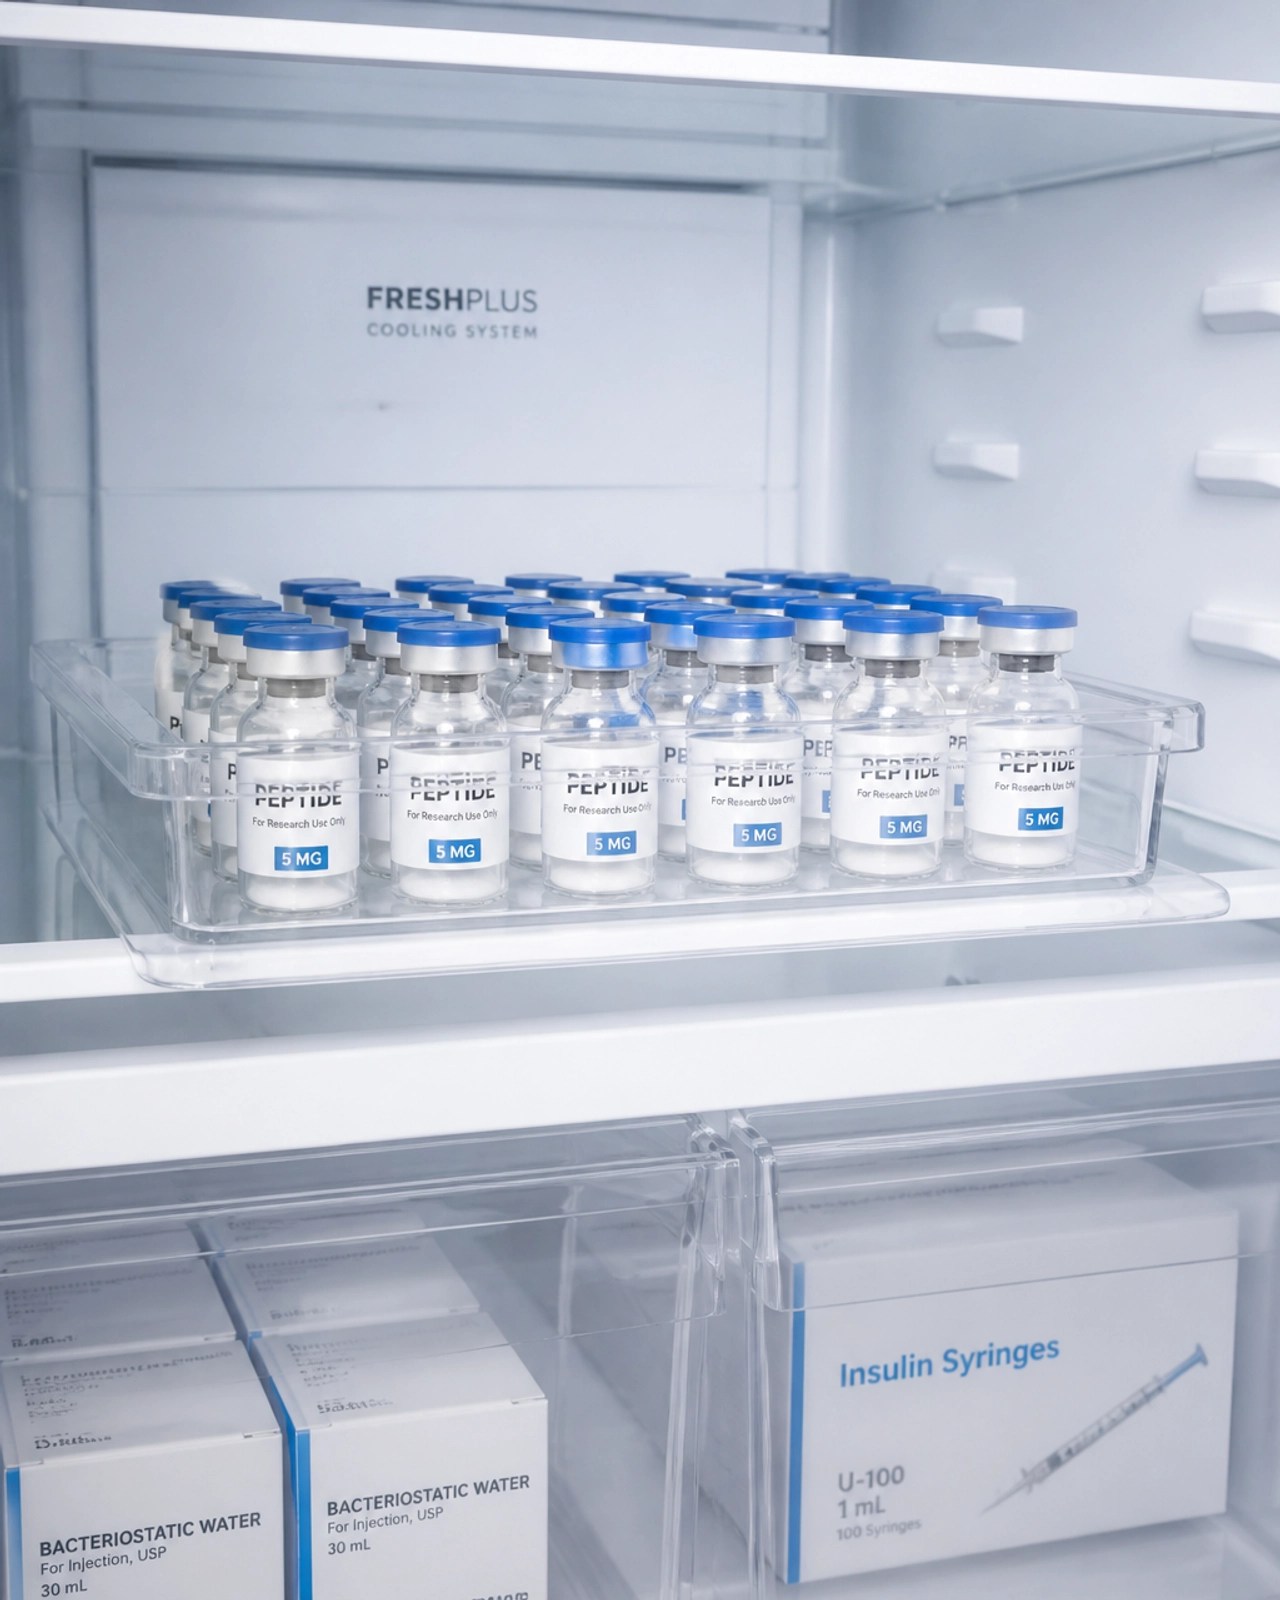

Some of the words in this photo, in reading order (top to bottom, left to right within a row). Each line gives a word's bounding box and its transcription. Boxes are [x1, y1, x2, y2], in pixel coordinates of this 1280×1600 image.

[366, 285, 539, 313] FRESHPLUS
[367, 322, 457, 338] COOLING
[465, 324, 539, 339] SYSTEM
[861, 756, 940, 780] PEPTIDE
[999, 748, 1075, 773] PEPTIDE
[567, 767, 650, 795] PEPTIDE
[714, 760, 795, 788] PEPTIDE
[255, 780, 342, 808] PEPTIDE
[410, 772, 496, 801] PEPTIDE
[857, 788, 871, 798] For
[873, 789, 913, 799] Research
[994, 781, 1009, 791] For
[563, 803, 577, 814] For
[579, 805, 621, 815] Research
[711, 796, 725, 806] For
[253, 816, 266, 827] For
[267, 818, 310, 829] Research
[407, 809, 420, 820] For
[422, 811, 464, 822] Research
[465, 811, 481, 821] Use
[1025, 813, 1034, 826] 5
[1038, 812, 1059, 825] MG
[741, 828, 750, 842] 5
[754, 827, 777, 842] MG
[887, 821, 896, 834] 5
[900, 820, 922, 834] MG
[436, 844, 446, 859] 5
[450, 843, 475, 859] MG
[594, 837, 604, 851] 5
[608, 836, 631, 850] MG
[282, 852, 292, 866] 5
[296, 850, 322, 866] MG
[841, 1353, 933, 1387] Insulin
[942, 1339, 1060, 1377] Syringes
[838, 1465, 905, 1492] U-100
[326, 1483, 469, 1516] BACTERIOSTATIC
[473, 1475, 530, 1496] WATER
[838, 1500, 848, 1518] 1
[855, 1496, 886, 1517] mL
[327, 1521, 350, 1535] For
[352, 1512, 413, 1532] Injection,
[417, 1506, 444, 1522] USP
[836, 1525, 862, 1541] 100
[865, 1518, 922, 1539] Syringes
[40, 1521, 194, 1557] BACTERIOSTATIC
[199, 1512, 261, 1534] WATER
[328, 1541, 346, 1556] 30
[349, 1538, 371, 1553] mL
[41, 1562, 64, 1575] For
[68, 1553, 133, 1573] Injection,
[137, 1546, 167, 1561] USP
[41, 1583, 60, 1598] 30
[64, 1579, 87, 1594] mL
